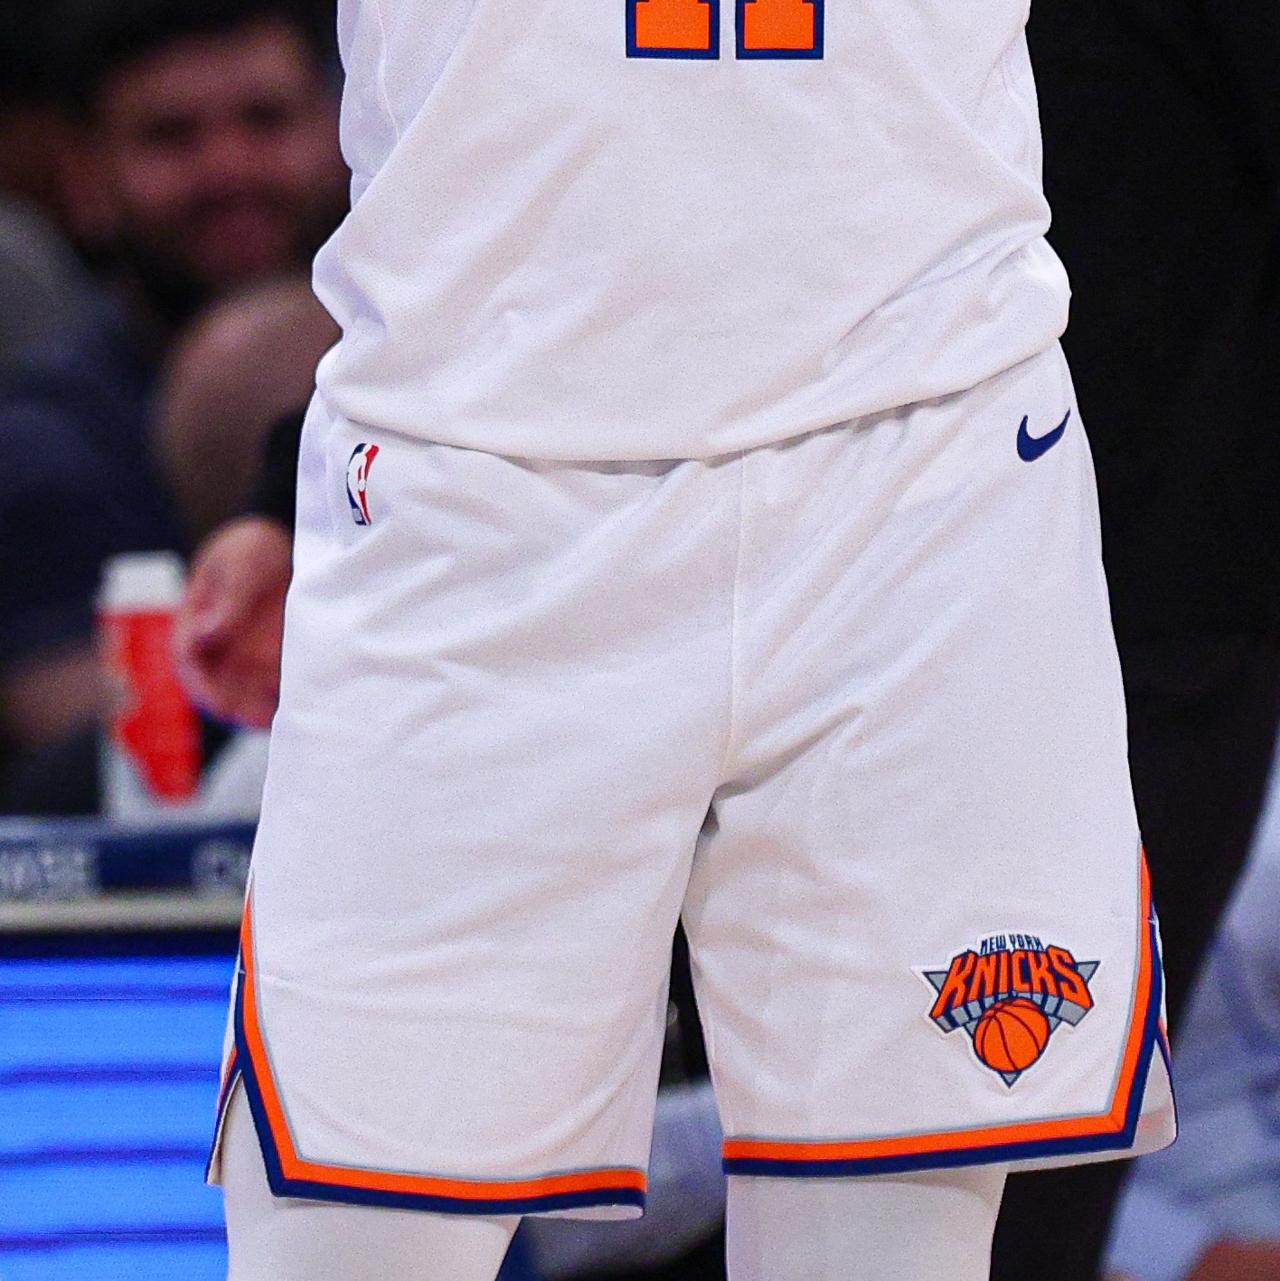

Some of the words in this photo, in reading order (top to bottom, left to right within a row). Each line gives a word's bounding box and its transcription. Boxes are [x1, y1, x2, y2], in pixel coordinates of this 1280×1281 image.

[980, 934, 1007, 956] NEW
[1008, 933, 1045, 951] YORK
[929, 944, 1095, 1022] KNICKS
